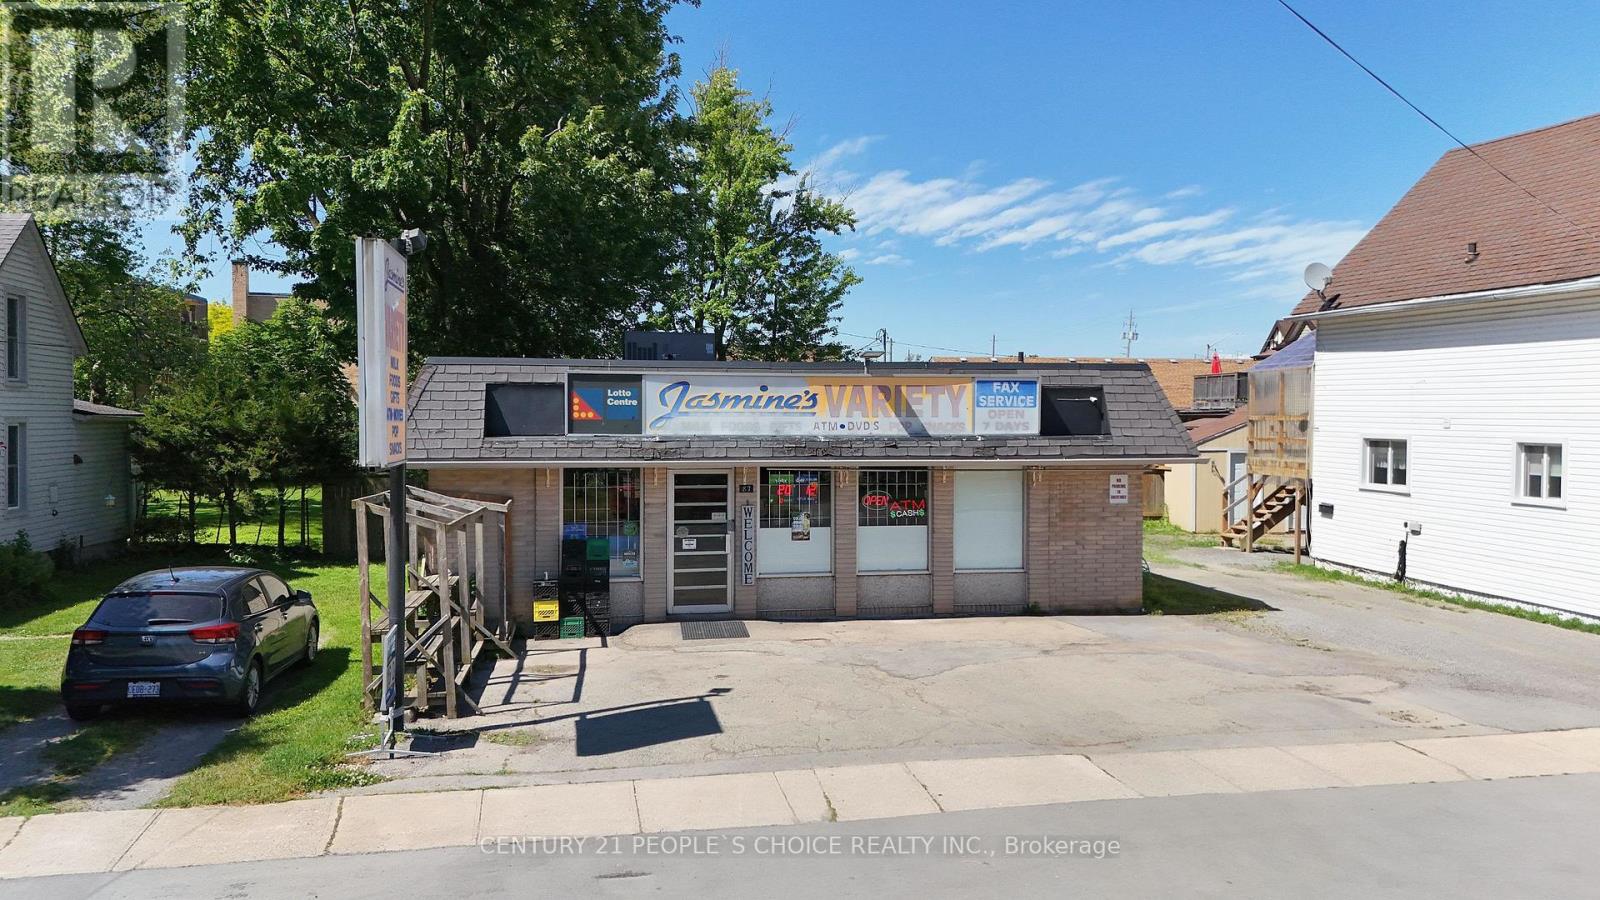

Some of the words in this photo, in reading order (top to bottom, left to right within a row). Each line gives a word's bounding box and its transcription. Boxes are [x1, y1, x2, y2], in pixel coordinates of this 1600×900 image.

[607, 389, 631, 397] Lotto
[993, 382, 1020, 393] FAX
[607, 398, 638, 406] Centre
[649, 380, 819, 431] Jasmine's
[824, 384, 967, 418] VARIETY
[979, 395, 1035, 407] SERVICE
[988, 409, 1025, 420] OPEN
[982, 422, 991, 431] 7
[995, 421, 1030, 431] DAYS
[864, 495, 889, 506] OPEN
[890, 499, 926, 511] ATM
[743, 506, 754, 585] WELCOME
